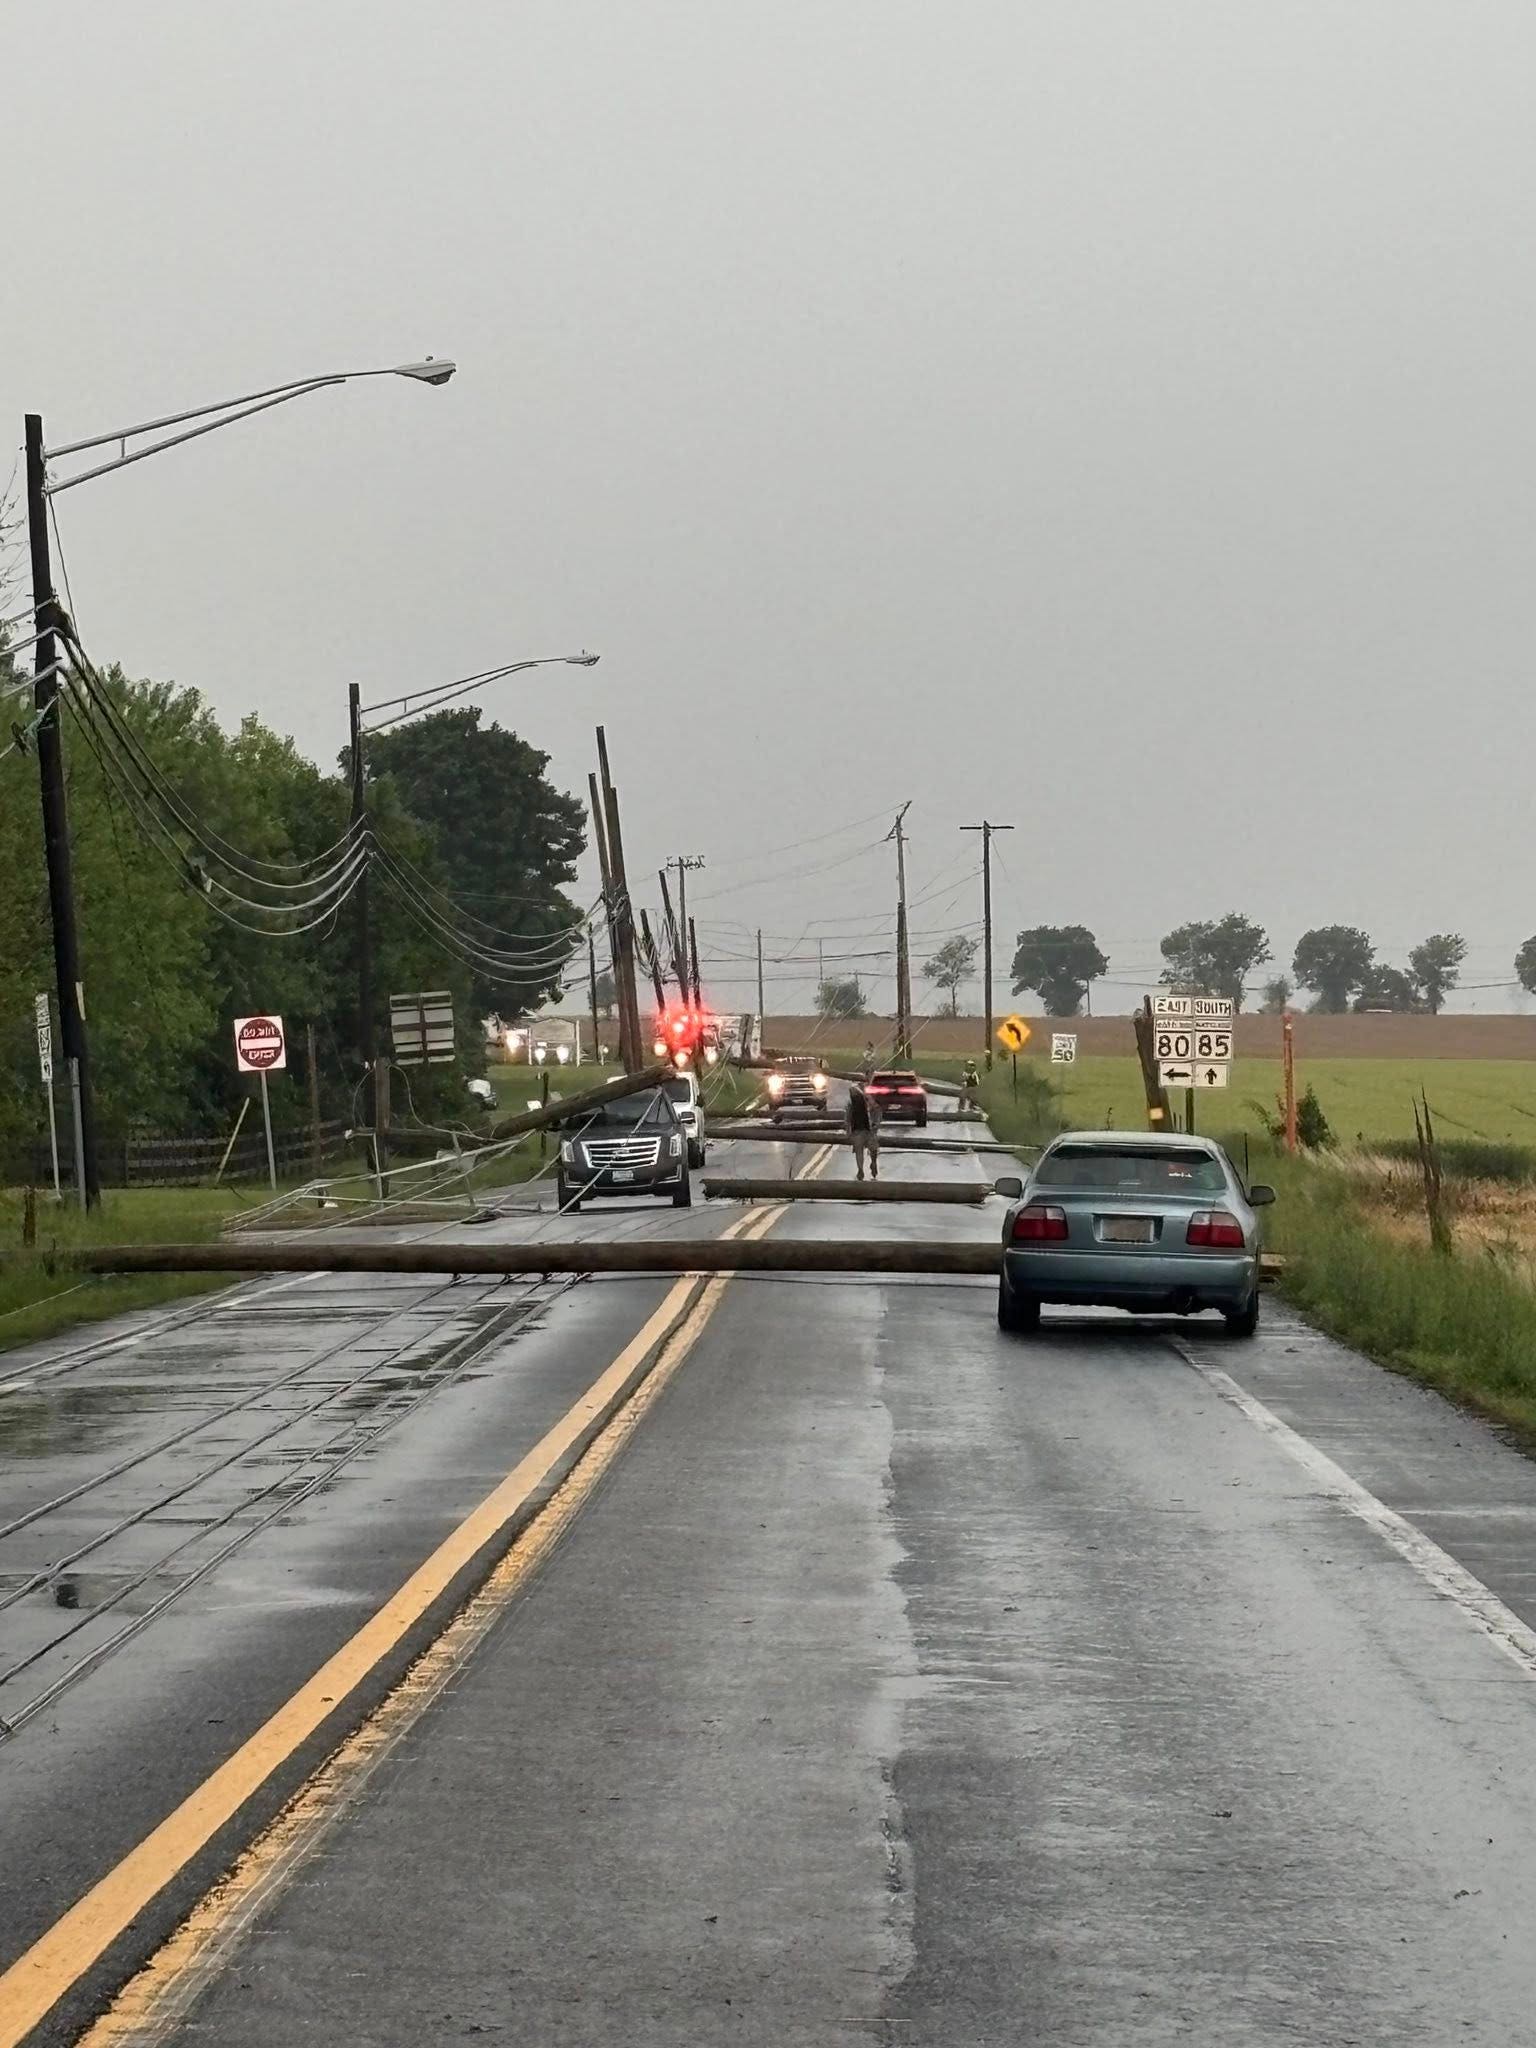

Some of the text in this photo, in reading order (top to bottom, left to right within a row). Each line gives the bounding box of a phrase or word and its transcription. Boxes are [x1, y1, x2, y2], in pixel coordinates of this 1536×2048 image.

[1195, 1000, 1232, 1015] SOUTH
[1157, 1034, 1190, 1057] 80
[1198, 1034, 1230, 1057] 85
